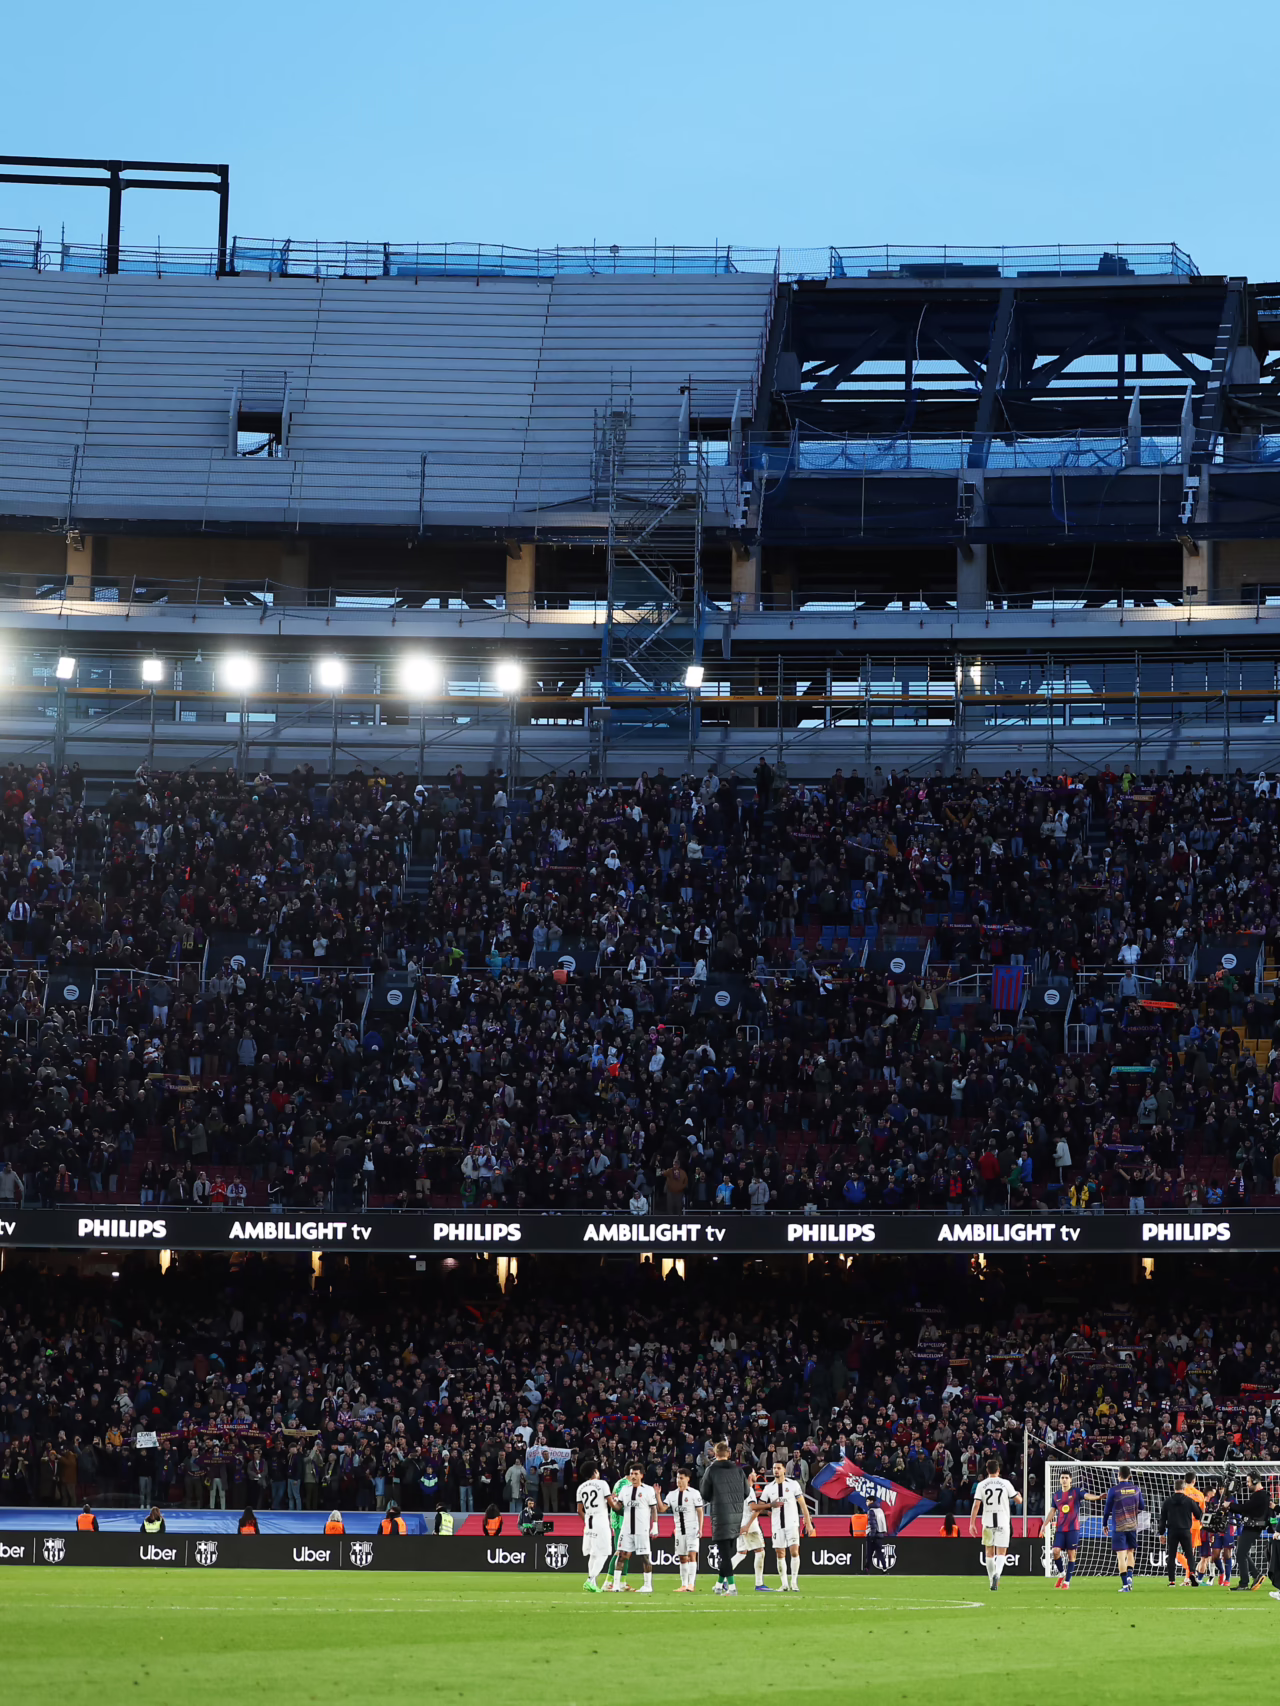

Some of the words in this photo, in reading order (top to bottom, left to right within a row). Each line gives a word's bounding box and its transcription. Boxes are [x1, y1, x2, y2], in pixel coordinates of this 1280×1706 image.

[79, 1219, 166, 1239] PHILIPS
[229, 1221, 347, 1240] AMBILIGHT
[351, 1223, 372, 1240] tv
[434, 1222, 521, 1241] PHILIPS
[583, 1223, 701, 1242] AMBILIGHT
[706, 1225, 725, 1241] tv
[788, 1224, 875, 1242] PHILIPS
[938, 1223, 1055, 1242] AMBILIGHT
[1060, 1225, 1080, 1241] tv
[1143, 1223, 1230, 1241] PHILIPS
[582, 1490, 599, 1510] 22
[985, 1488, 1003, 1505] 27
[0, 1542, 25, 1558] ber
[140, 1545, 176, 1560] Uber
[293, 1546, 330, 1561] Uber
[487, 1548, 526, 1563] Uber
[649, 1550, 680, 1565] Ube
[812, 1550, 851, 1565] Uber
